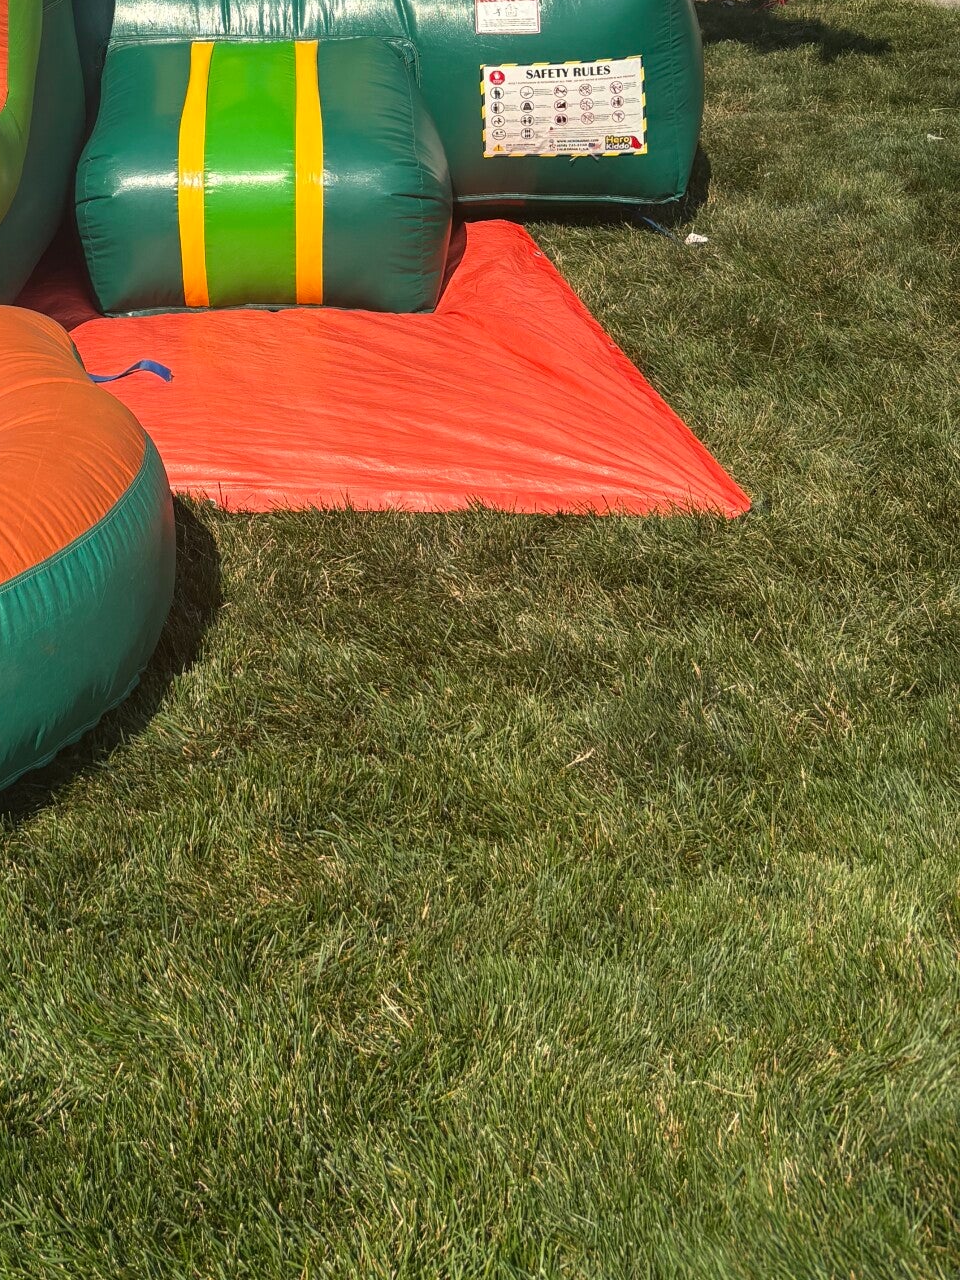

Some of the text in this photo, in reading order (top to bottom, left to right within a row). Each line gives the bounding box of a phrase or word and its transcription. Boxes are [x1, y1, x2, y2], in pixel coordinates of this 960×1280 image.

[526, 65, 611, 79] SAFETY RULES
[605, 135, 630, 145] Hero
[605, 143, 630, 151] Kiddo
